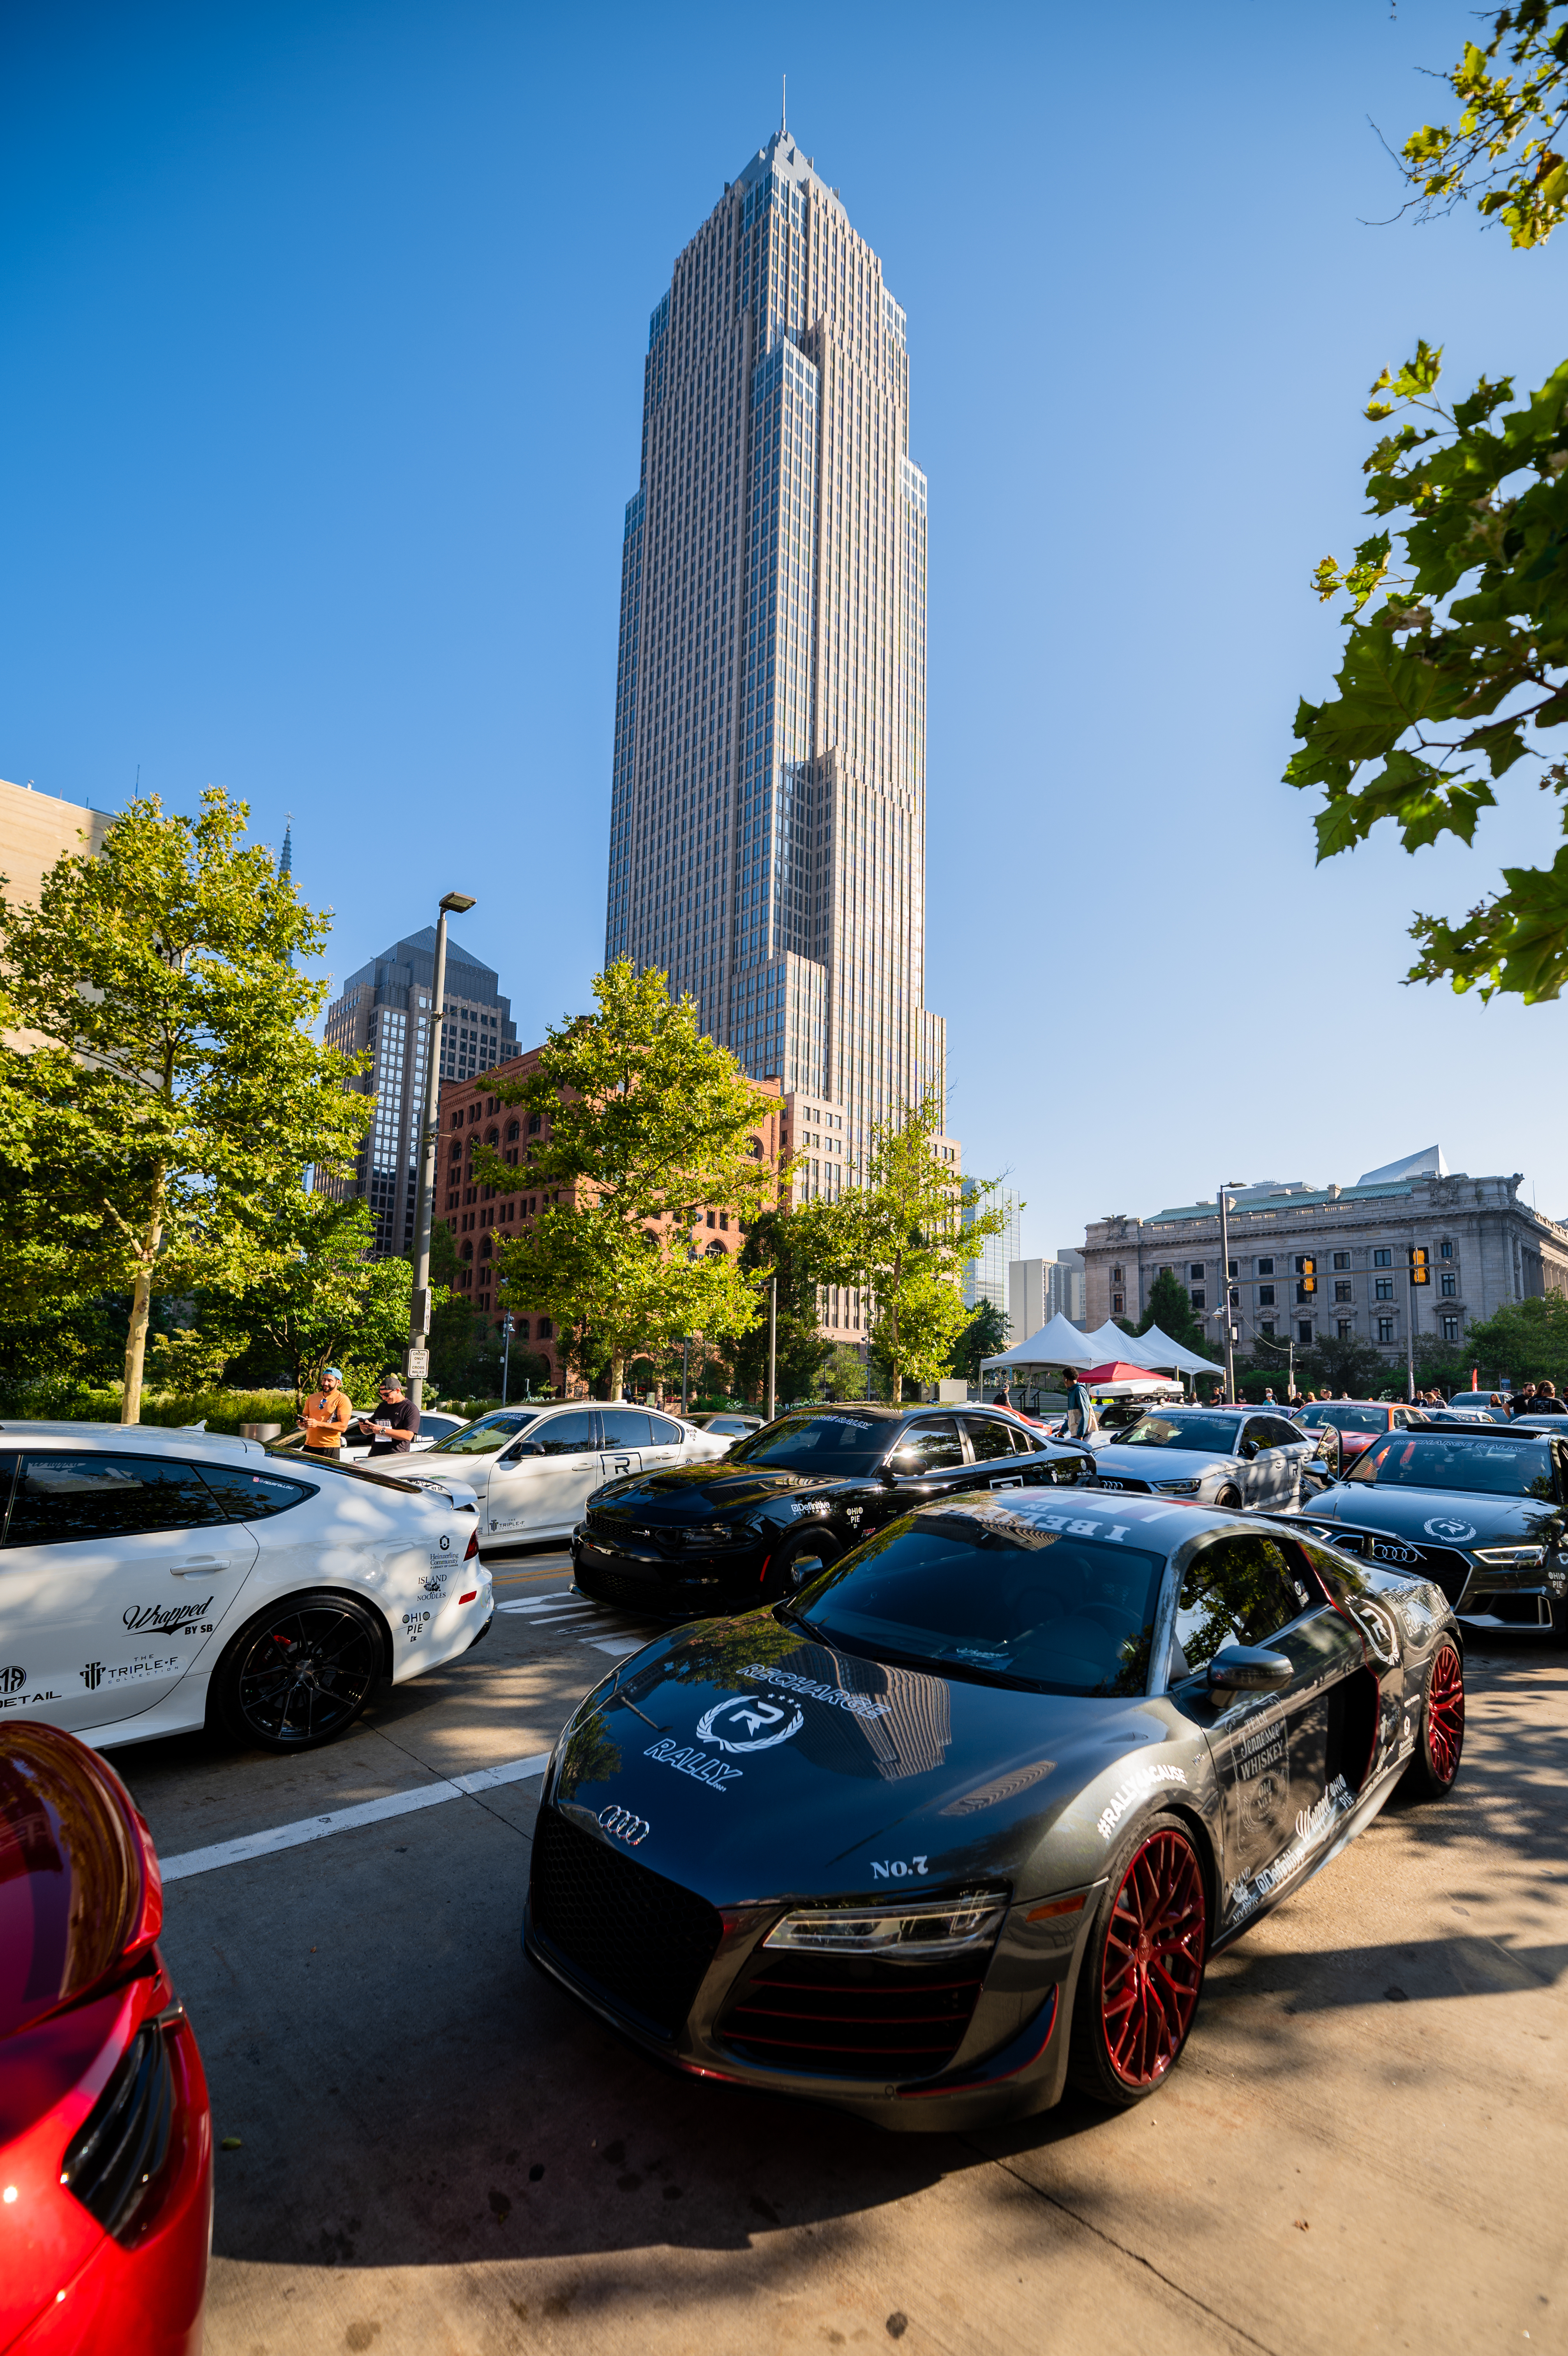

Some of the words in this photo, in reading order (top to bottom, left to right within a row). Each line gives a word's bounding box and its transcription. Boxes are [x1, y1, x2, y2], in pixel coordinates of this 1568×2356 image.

[834, 1417, 873, 1429] RALLY
[1199, 1415, 1230, 1423] RALLY
[1475, 1443, 1527, 1453] RALLY
[797, 1501, 830, 1511] Definitive
[847, 1507, 863, 1515] OHIO
[1021, 1503, 1053, 1512] IN
[850, 1515, 860, 1524] PIE
[1104, 1525, 1131, 1542] I
[418, 1574, 447, 1584] ISLAND
[1548, 1571, 1566, 1580] OHIO
[1552, 1580, 1563, 1589] PIE
[417, 1592, 446, 1601] NOODLES
[123, 1596, 214, 1630] Wrapped
[402, 1611, 430, 1624] OHIO
[184, 1626, 198, 1635] BY
[200, 1624, 213, 1633] SB
[407, 1623, 423, 1635] PIE
[108, 1666, 179, 1684] COLLECTION
[736, 1663, 891, 1719] RECHARGE
[0, 1691, 62, 1708] ETAIL
[1244, 1710, 1268, 1733] TEAM
[1238, 1723, 1281, 1759] Tennessee
[644, 1738, 743, 1786] RALLY
[1240, 1739, 1283, 1781] WHISKEY
[1258, 1779, 1271, 1798] Old
[1330, 1773, 1346, 1797] OHIO
[1339, 1791, 1355, 1810] PIE
[1295, 1785, 1332, 1844] Wrapped
[1262, 1847, 1305, 1889] Definitive
